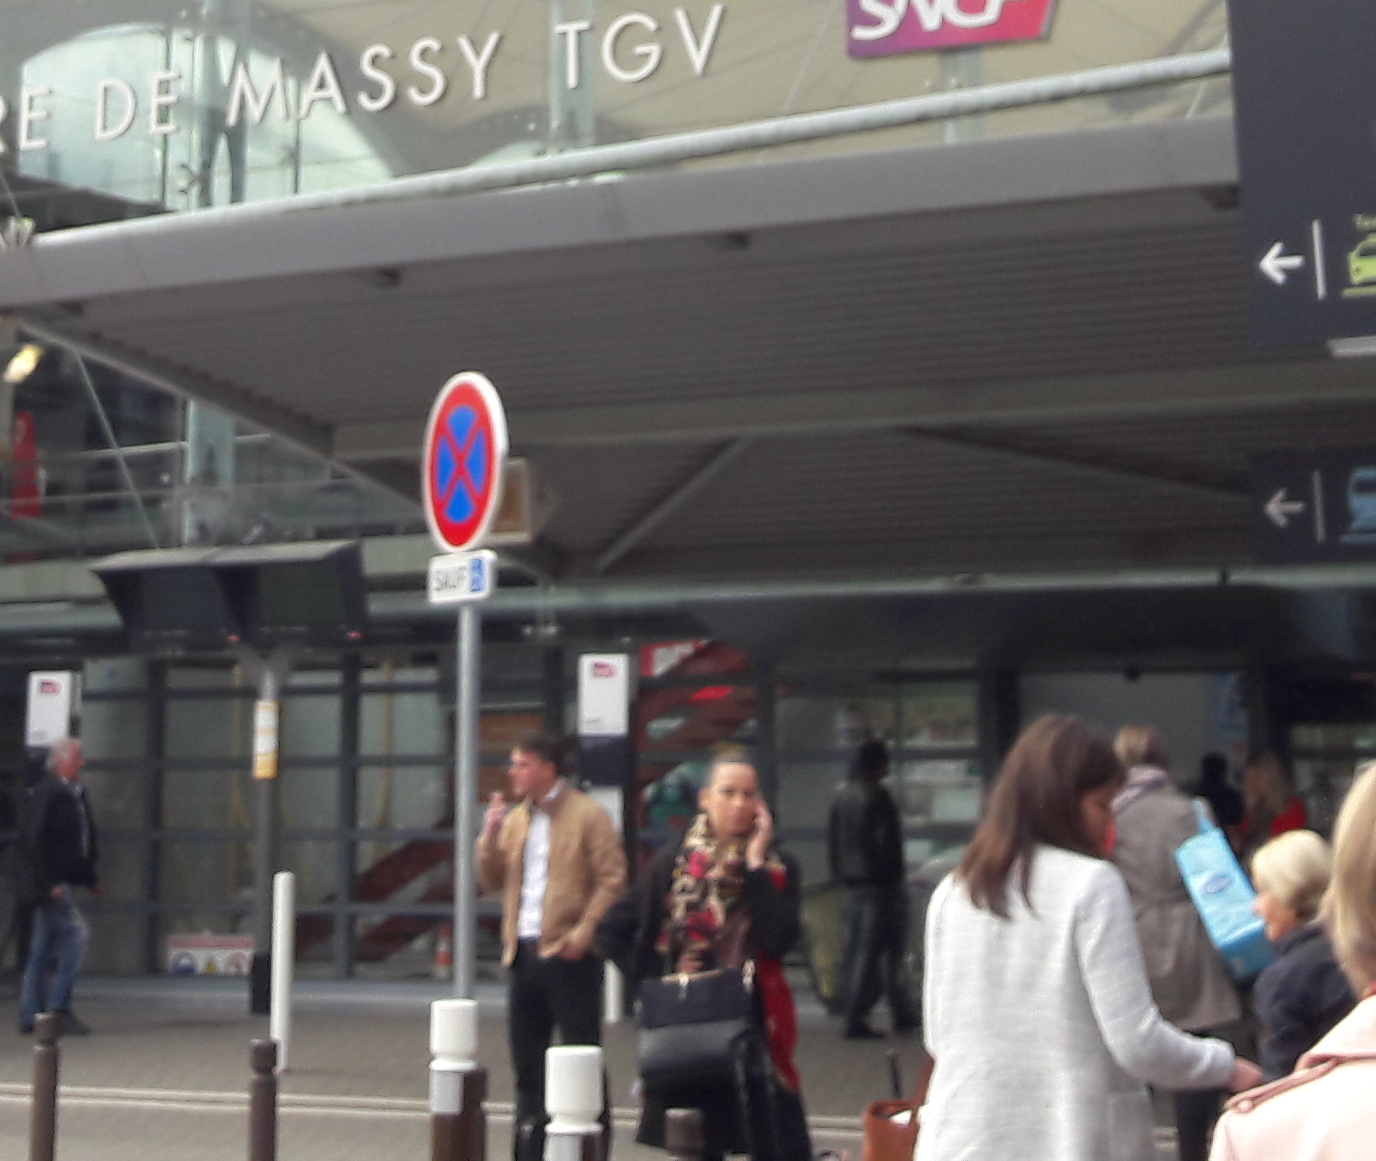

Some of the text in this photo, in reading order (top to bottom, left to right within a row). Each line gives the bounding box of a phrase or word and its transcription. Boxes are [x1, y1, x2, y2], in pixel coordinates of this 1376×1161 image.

[93, 70, 181, 142] DE
[226, 29, 504, 129] MASSY
[555, 3, 726, 91] TGV
